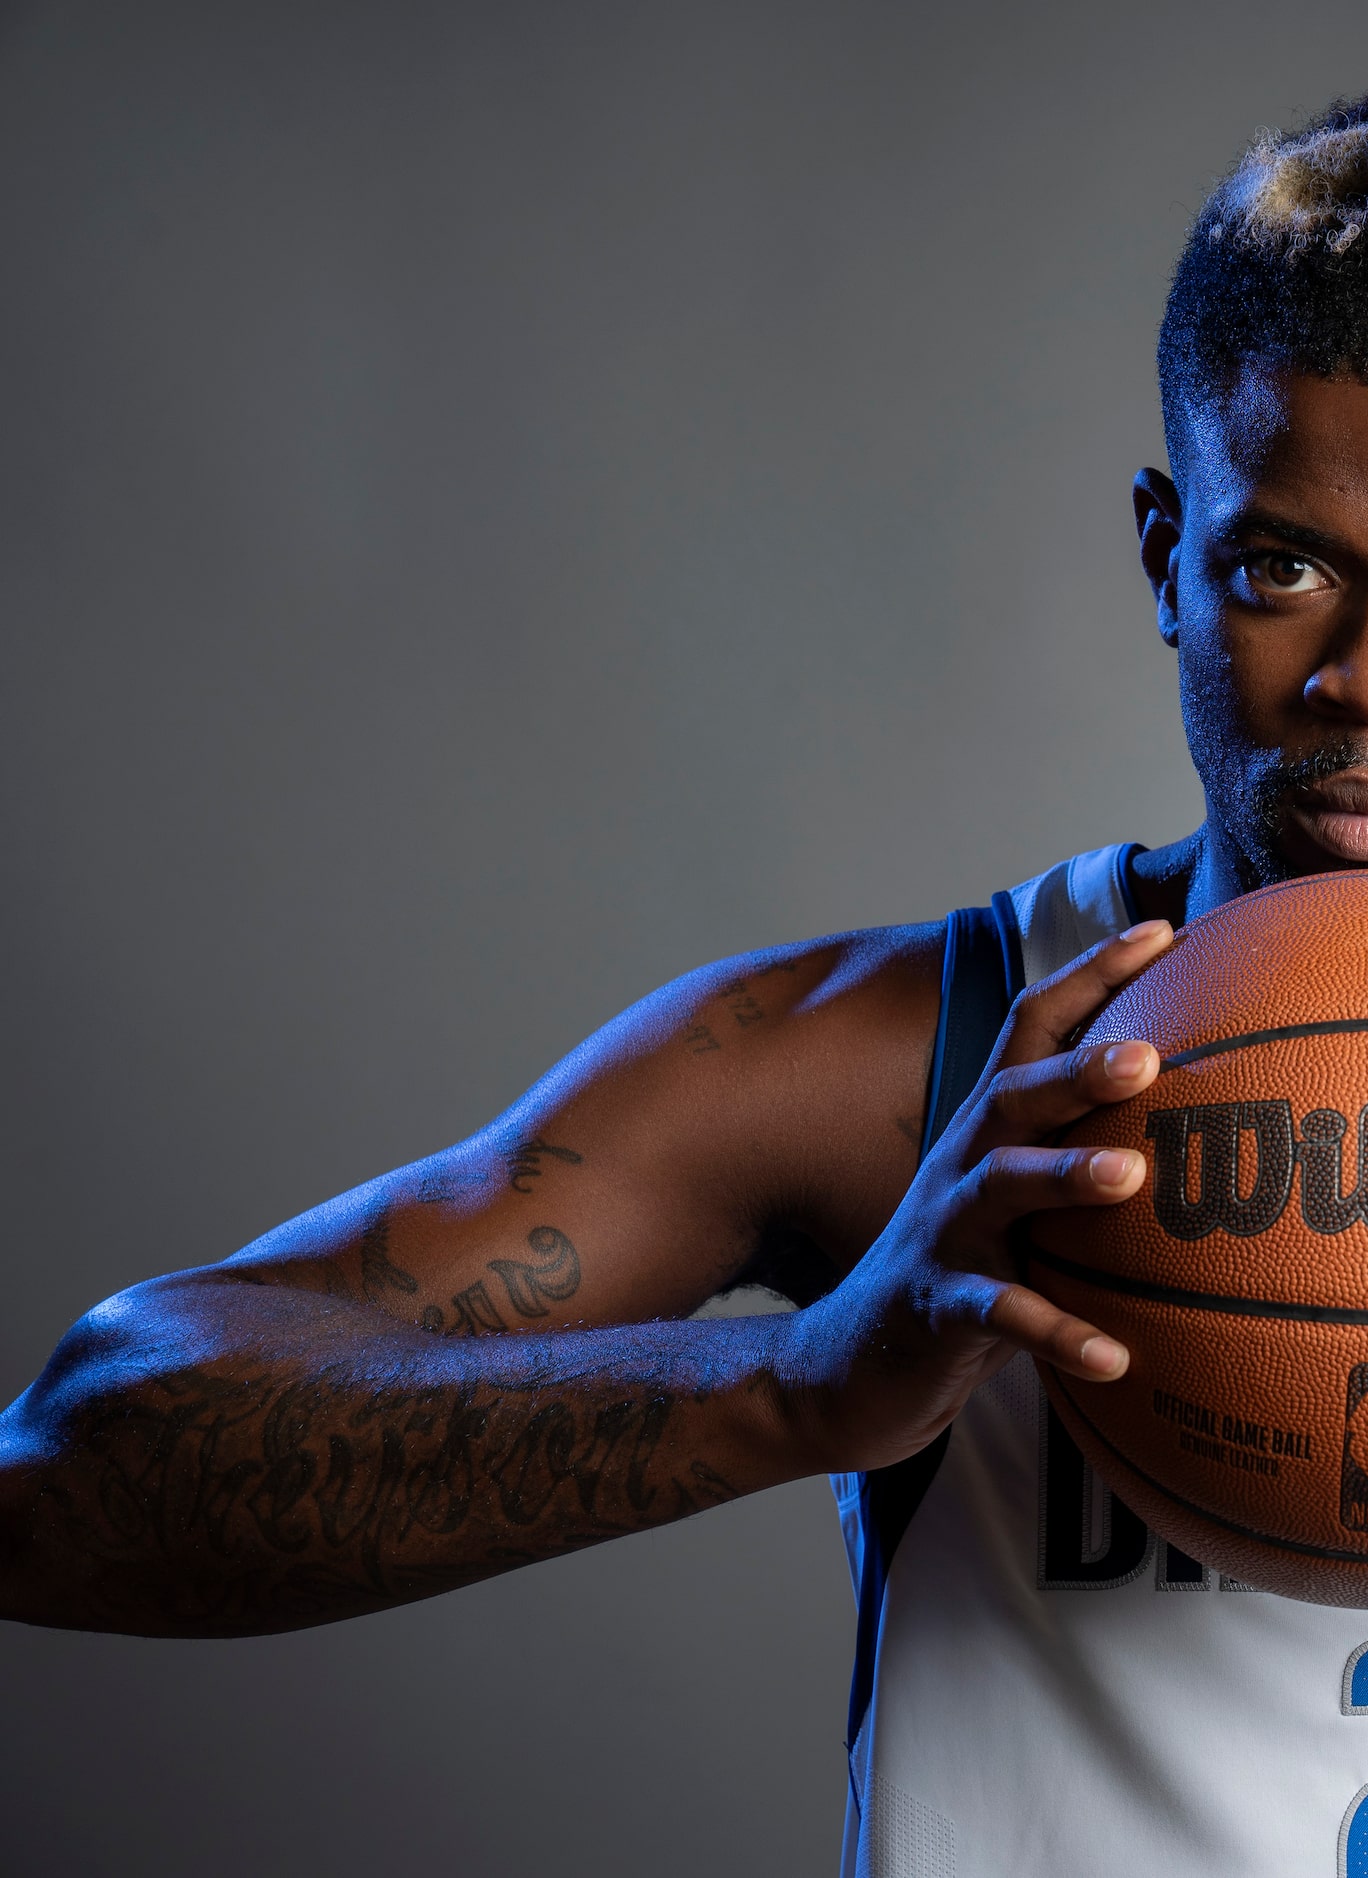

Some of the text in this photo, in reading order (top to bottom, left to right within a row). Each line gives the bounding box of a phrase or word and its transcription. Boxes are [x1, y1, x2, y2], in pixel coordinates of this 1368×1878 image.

[1153, 1388, 1313, 1460] OFFICIAL GAME BALL
[1179, 1430, 1279, 1477] GENUINE LEATHER
